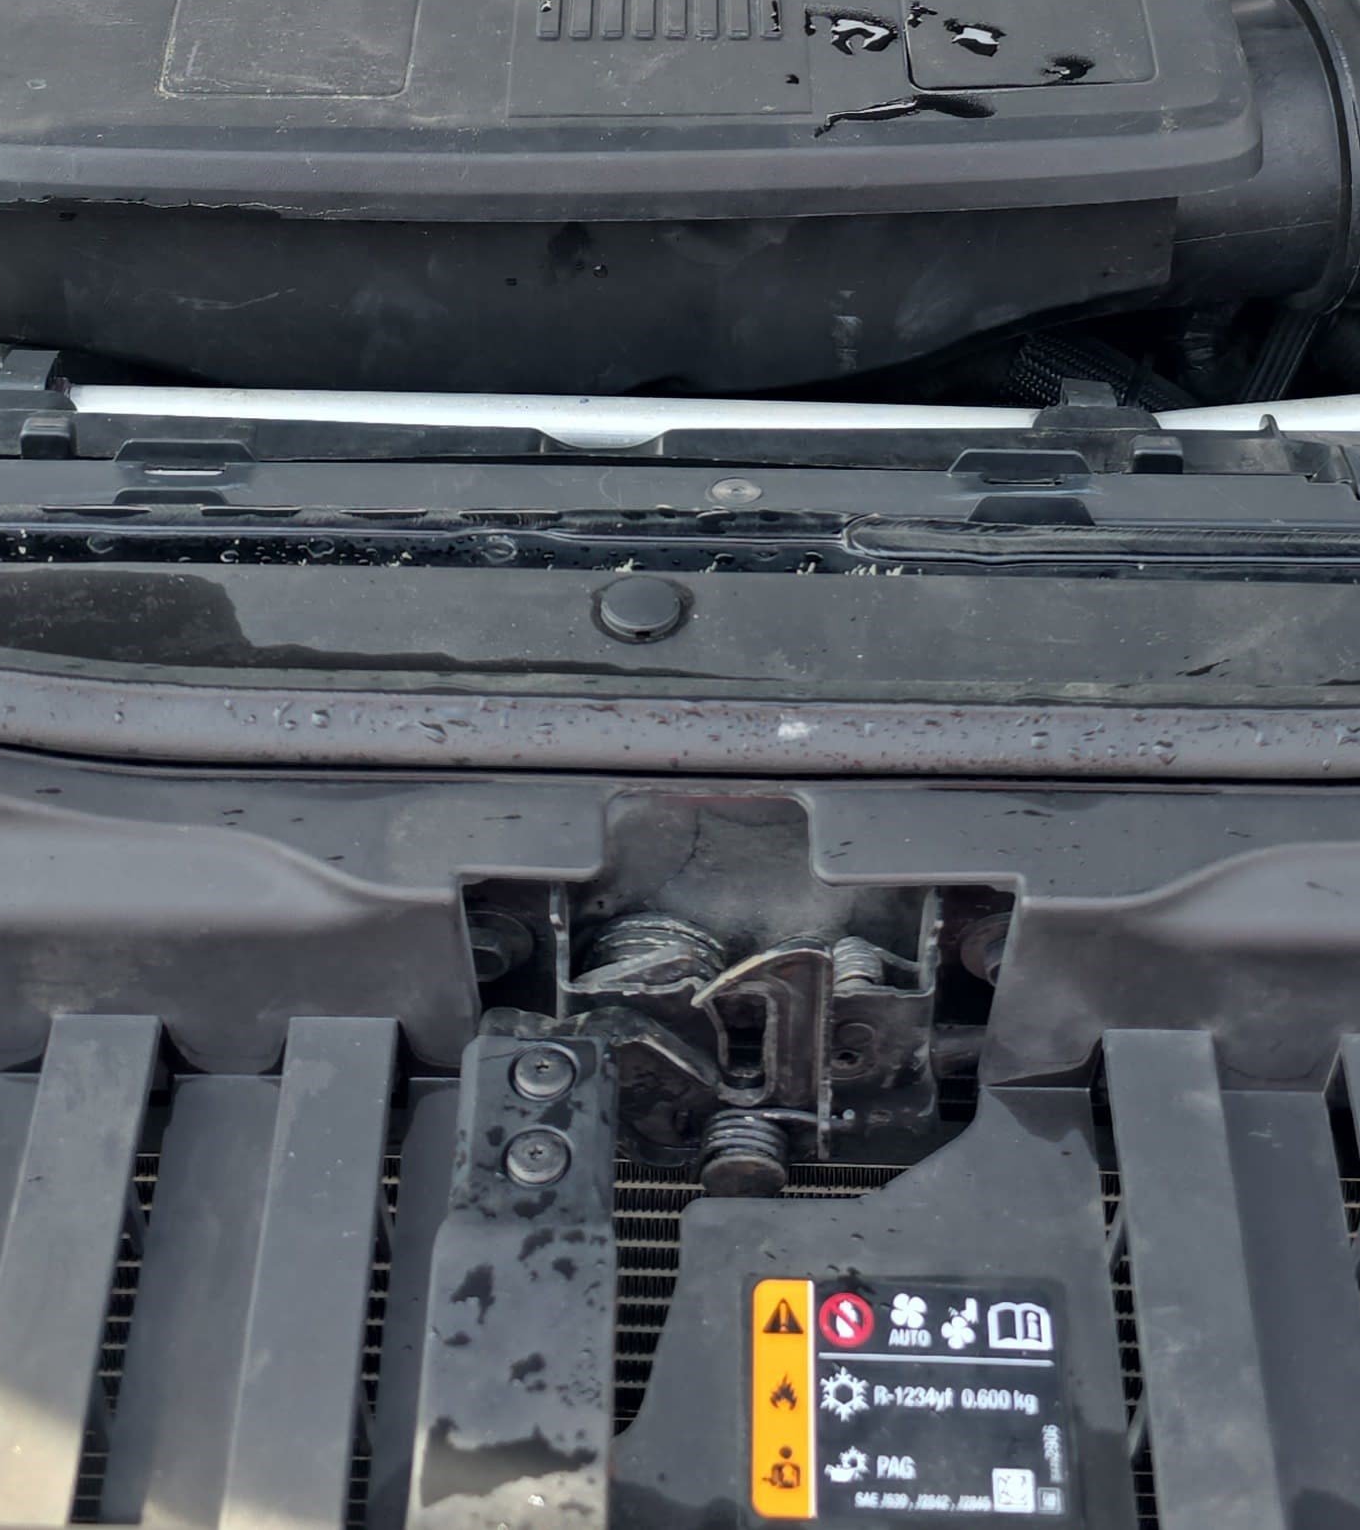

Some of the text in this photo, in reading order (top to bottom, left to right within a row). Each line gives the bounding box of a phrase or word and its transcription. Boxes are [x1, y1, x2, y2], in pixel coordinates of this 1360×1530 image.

[888, 1329, 932, 1348] AUTO
[873, 1384, 1039, 1415] R-1234yf 0.600 kg
[876, 1455, 918, 1480] PAG
[854, 1491, 879, 1508] SAE
